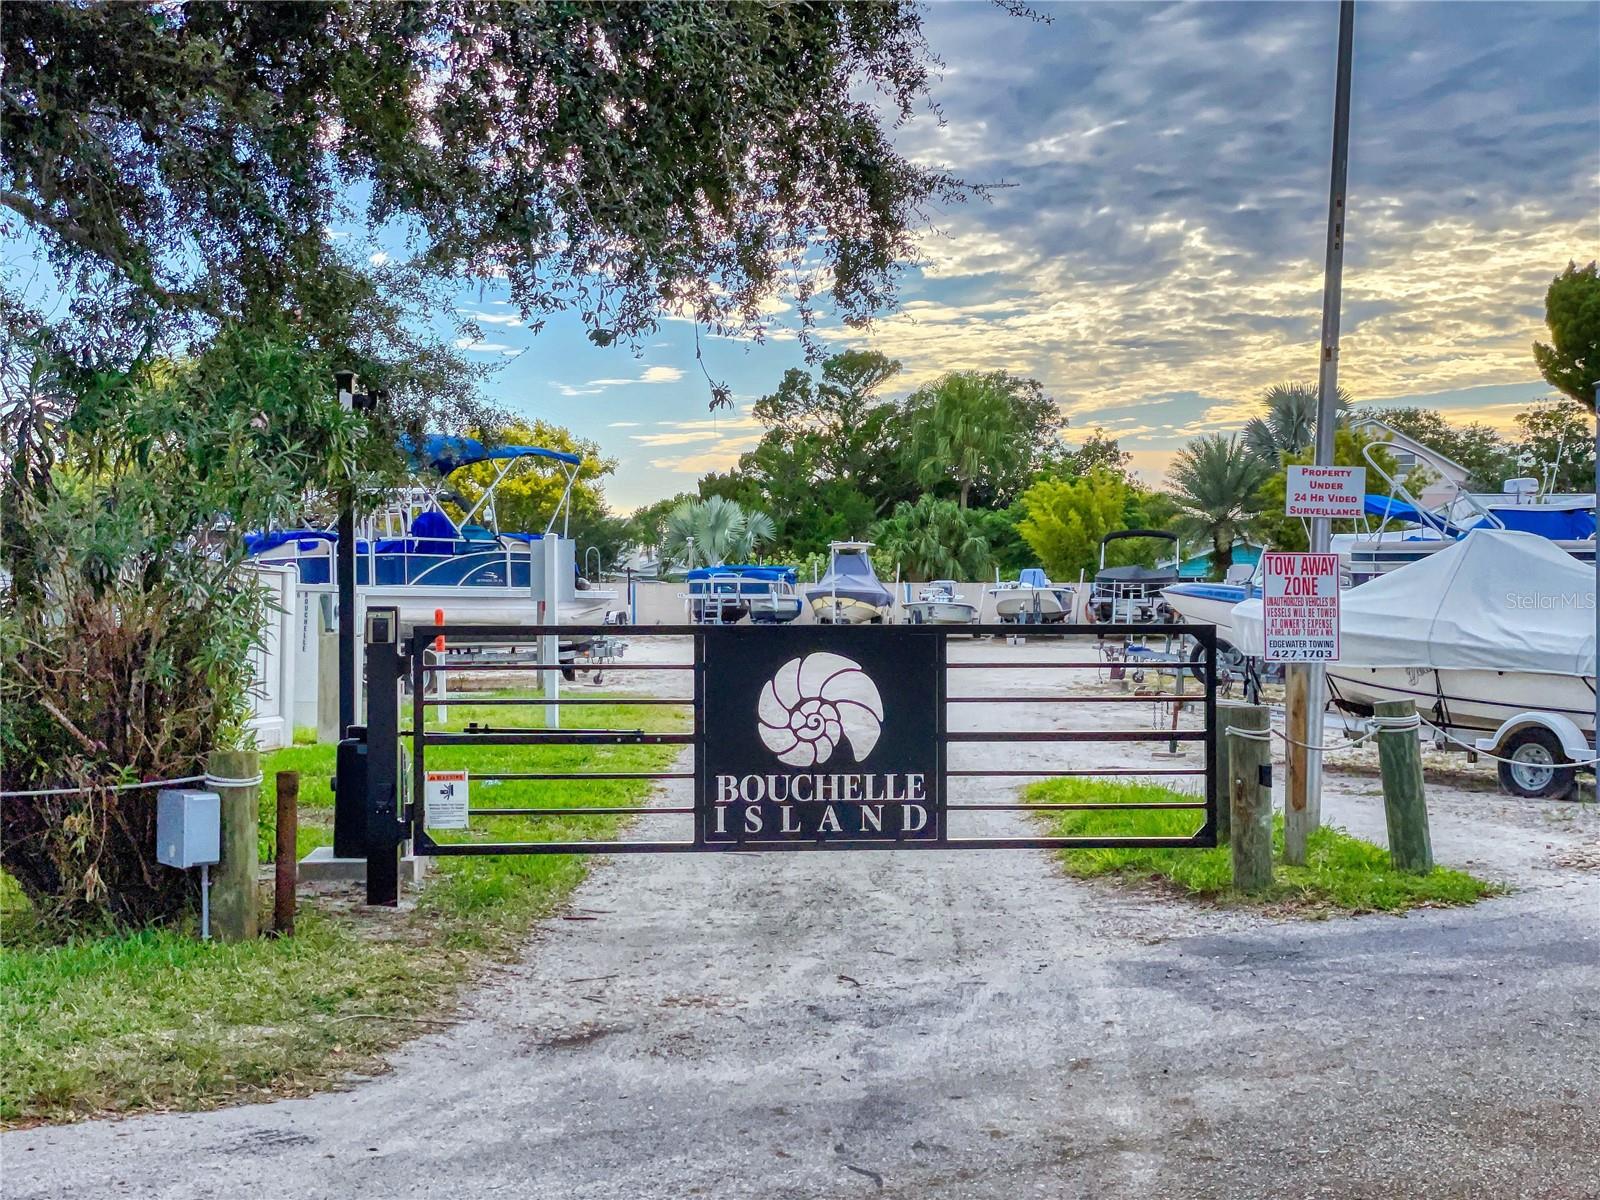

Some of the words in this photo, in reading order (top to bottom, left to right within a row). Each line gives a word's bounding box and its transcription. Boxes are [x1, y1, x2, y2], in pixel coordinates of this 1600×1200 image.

[1302, 467, 1352, 477] PROPERTY
[1309, 480, 1343, 490] UNDER
[1294, 493, 1307, 502] 24
[1328, 494, 1358, 503] VIDEO
[1289, 505, 1361, 516] SURVEILLANCE
[1266, 556, 1296, 575] TOW
[1300, 556, 1336, 576] AWAY
[1284, 576, 1318, 596] ZONE
[1266, 597, 1304, 606] UNAUTHORIZED
[1305, 597, 1329, 606] VEHICLES
[1329, 597, 1337, 606] OR
[1266, 608, 1291, 617] VESSELS
[1293, 608, 1306, 617] WILL
[1308, 608, 1316, 617] BE
[1317, 608, 1336, 617] TOWED
[1271, 619, 1278, 628] AT
[1279, 619, 1305, 628] OWNER'S
[1308, 619, 1332, 628] EXPENSE
[1269, 640, 1307, 648] EDGEWATER
[1309, 640, 1334, 648] TOWING
[1272, 650, 1332, 658] 427-1703
[715, 773, 926, 802] BOUCHELLE
[714, 804, 928, 833] ISLAND
